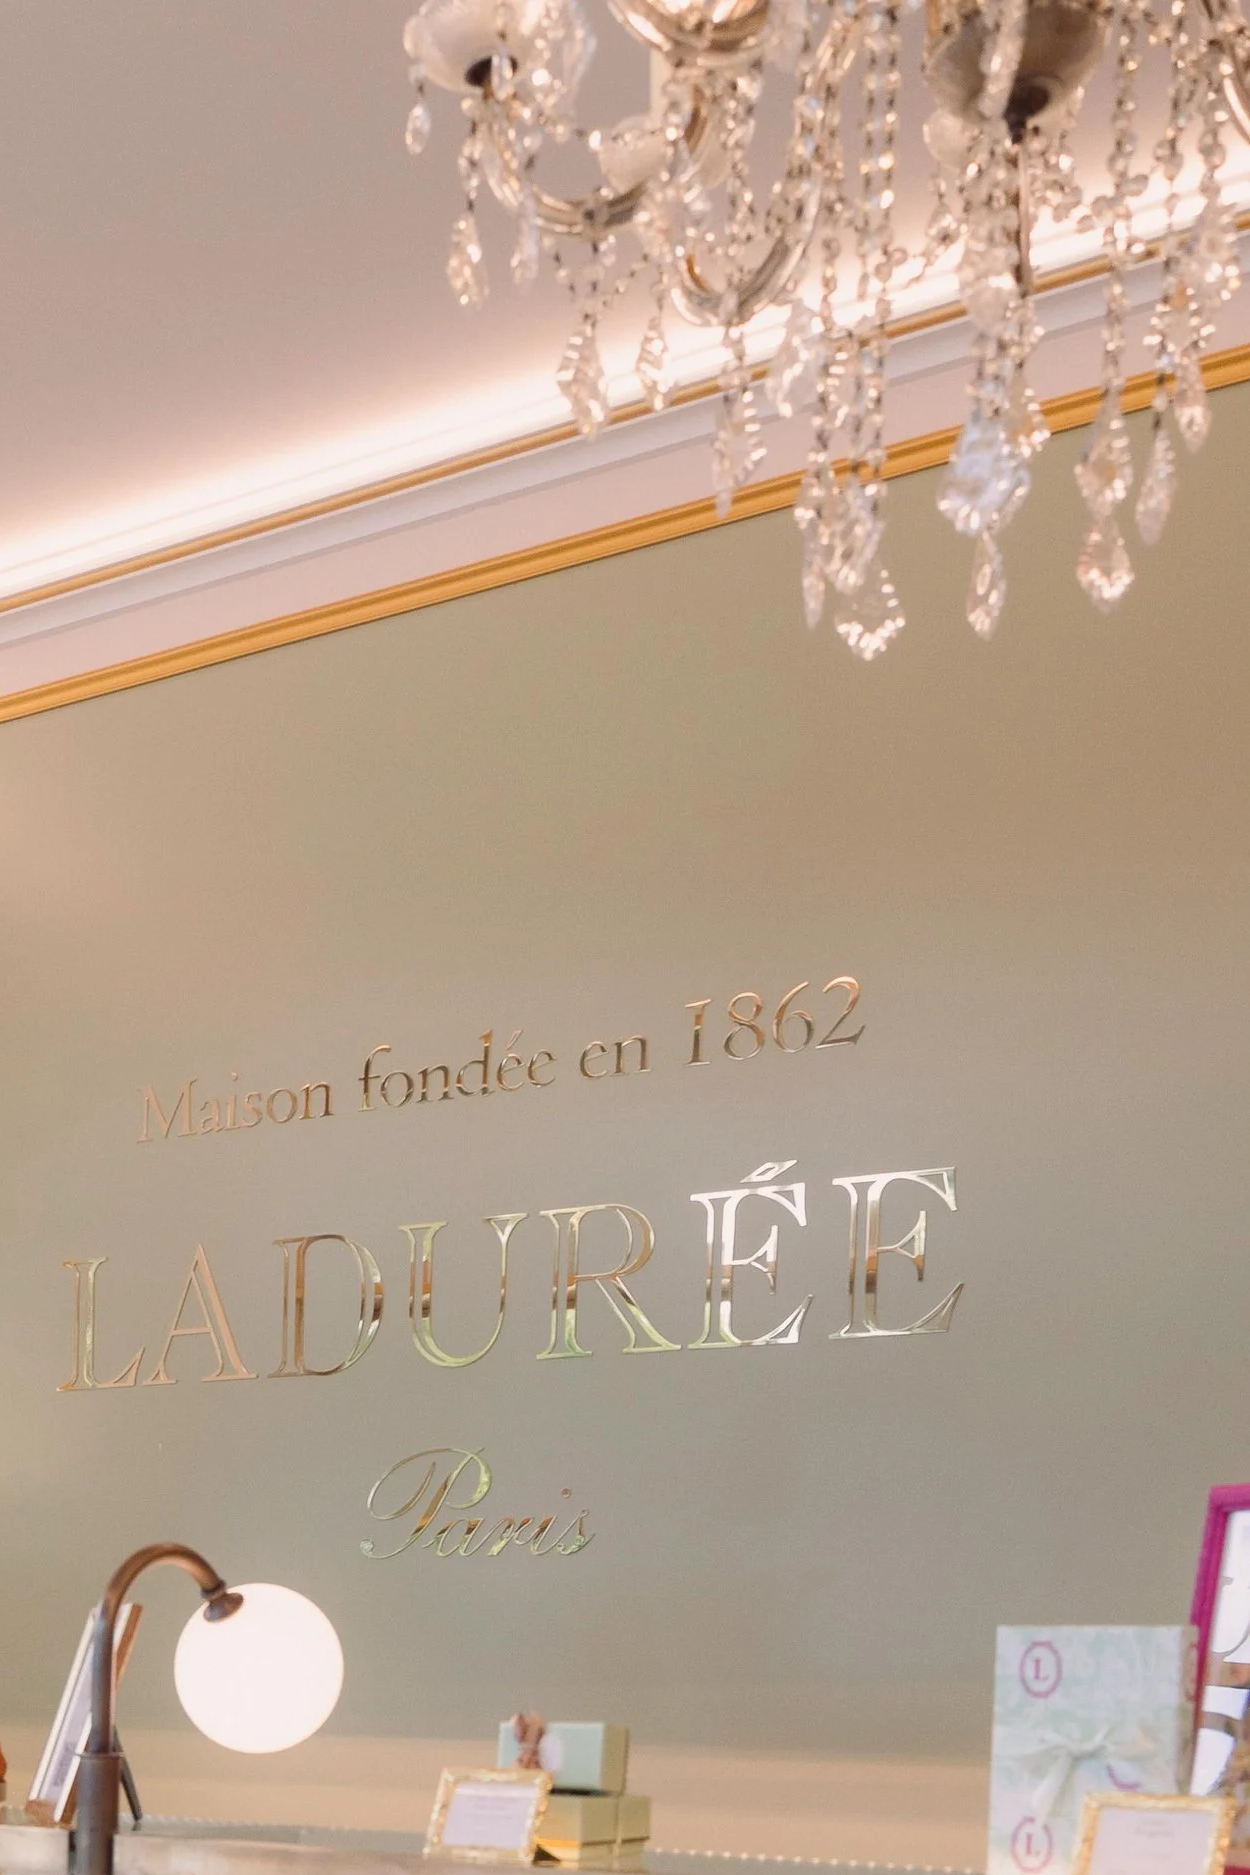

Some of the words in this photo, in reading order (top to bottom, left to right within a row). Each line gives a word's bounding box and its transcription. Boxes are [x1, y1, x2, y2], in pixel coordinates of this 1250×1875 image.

[135, 1071, 334, 1144] Maison
[357, 1028, 557, 1113] fondée
[579, 1031, 653, 1081] en
[684, 974, 867, 1069] 1862
[55, 1159, 966, 1392] LADURÉE
[359, 1446, 597, 1561] Paris
